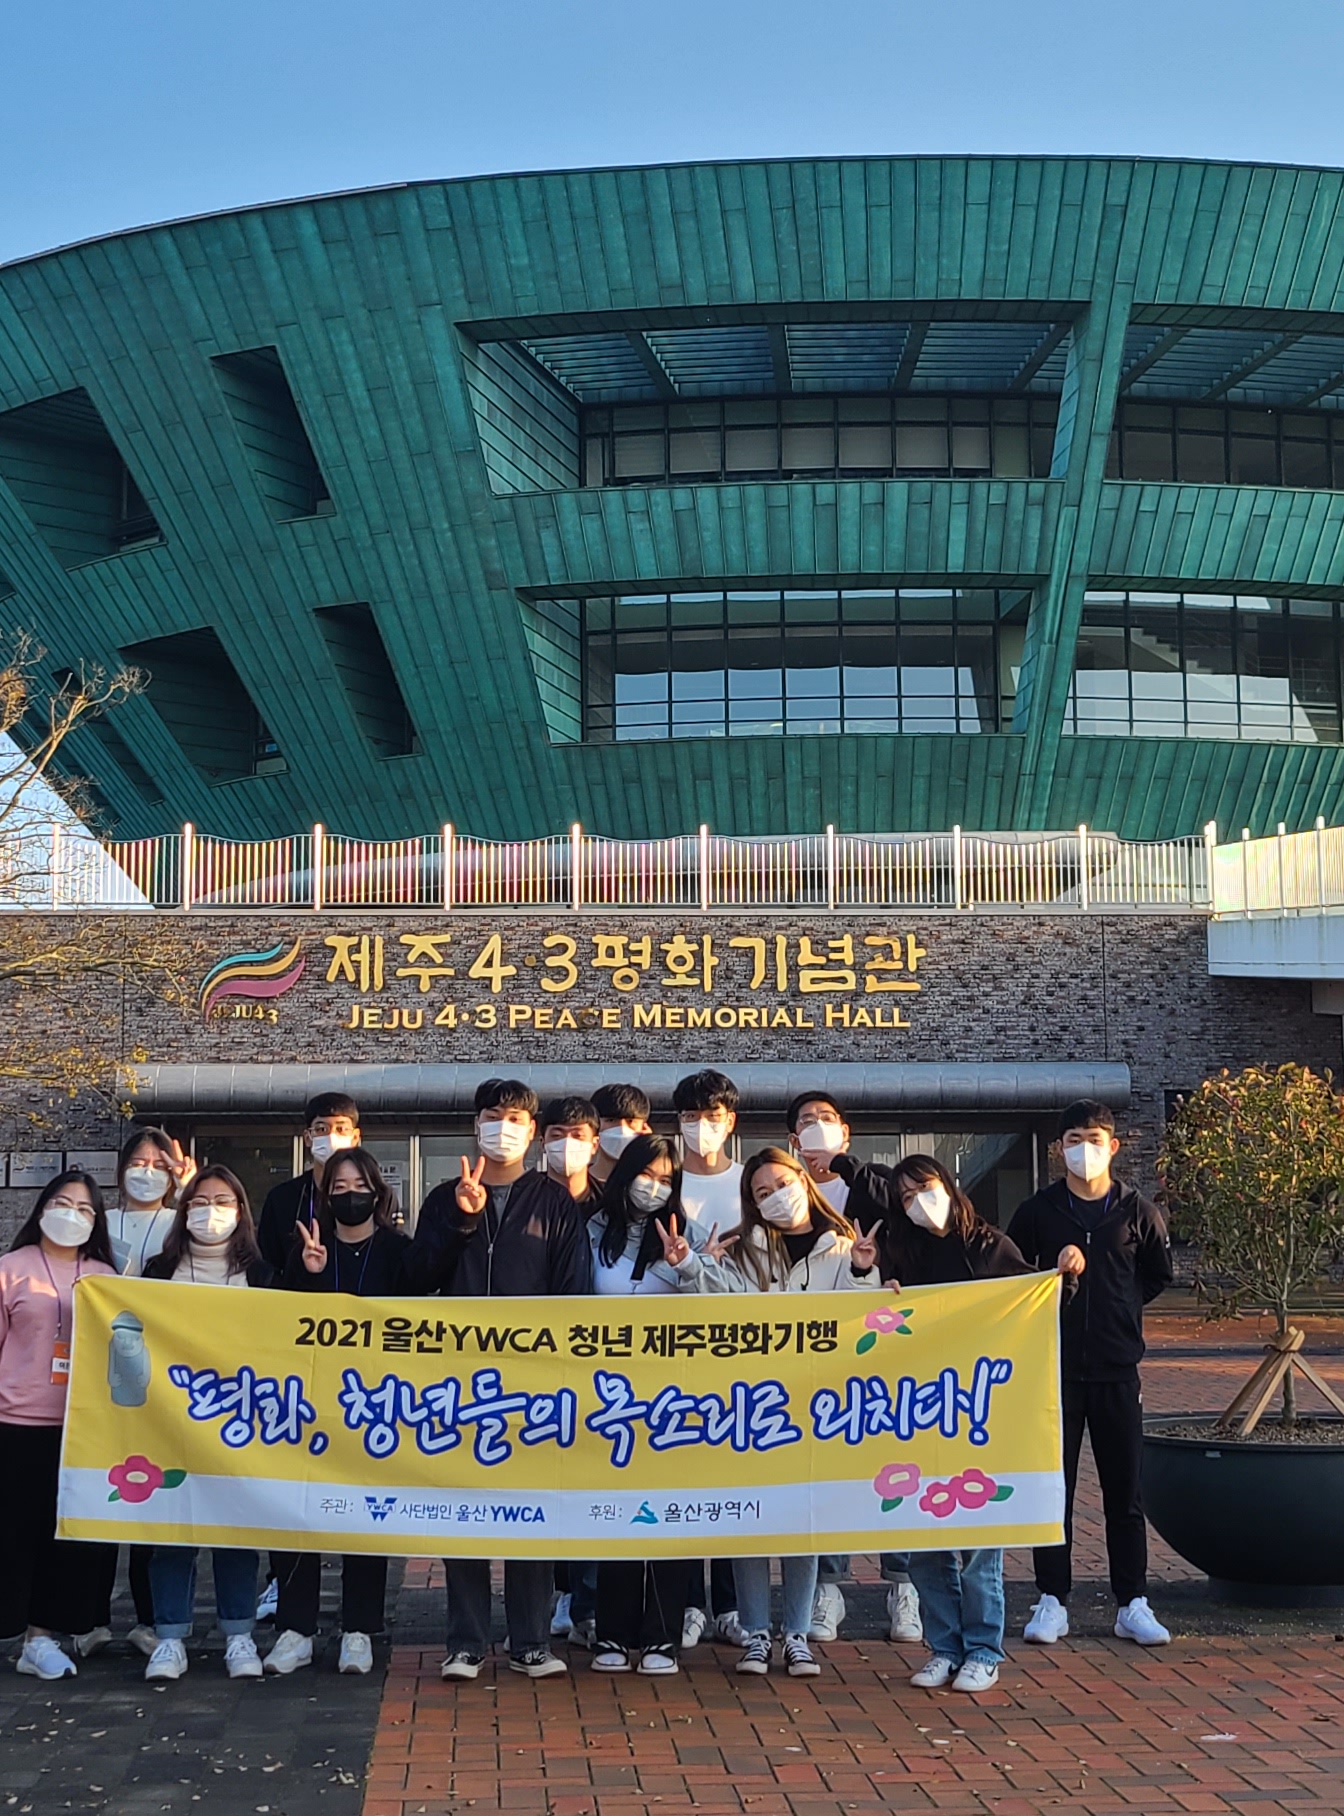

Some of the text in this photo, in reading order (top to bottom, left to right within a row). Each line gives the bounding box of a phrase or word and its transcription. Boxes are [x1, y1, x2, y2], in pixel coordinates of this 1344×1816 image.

[345, 1004, 423, 1029] JEJU
[632, 1003, 815, 1029] MEMORIAL
[825, 1003, 912, 1029] HALL
[294, 1317, 373, 1348] 2021
[568, 1324, 633, 1357] 청년
[641, 1320, 838, 1358] 제주평화기행
[339, 1366, 577, 1467] 청년들의
[586, 1369, 803, 1468] 목소리로
[400, 1503, 452, 1521] 사단법인
[455, 1504, 488, 1523] 울산
[490, 1506, 546, 1523] YWCA
[663, 1499, 761, 1523] 울산광역시
